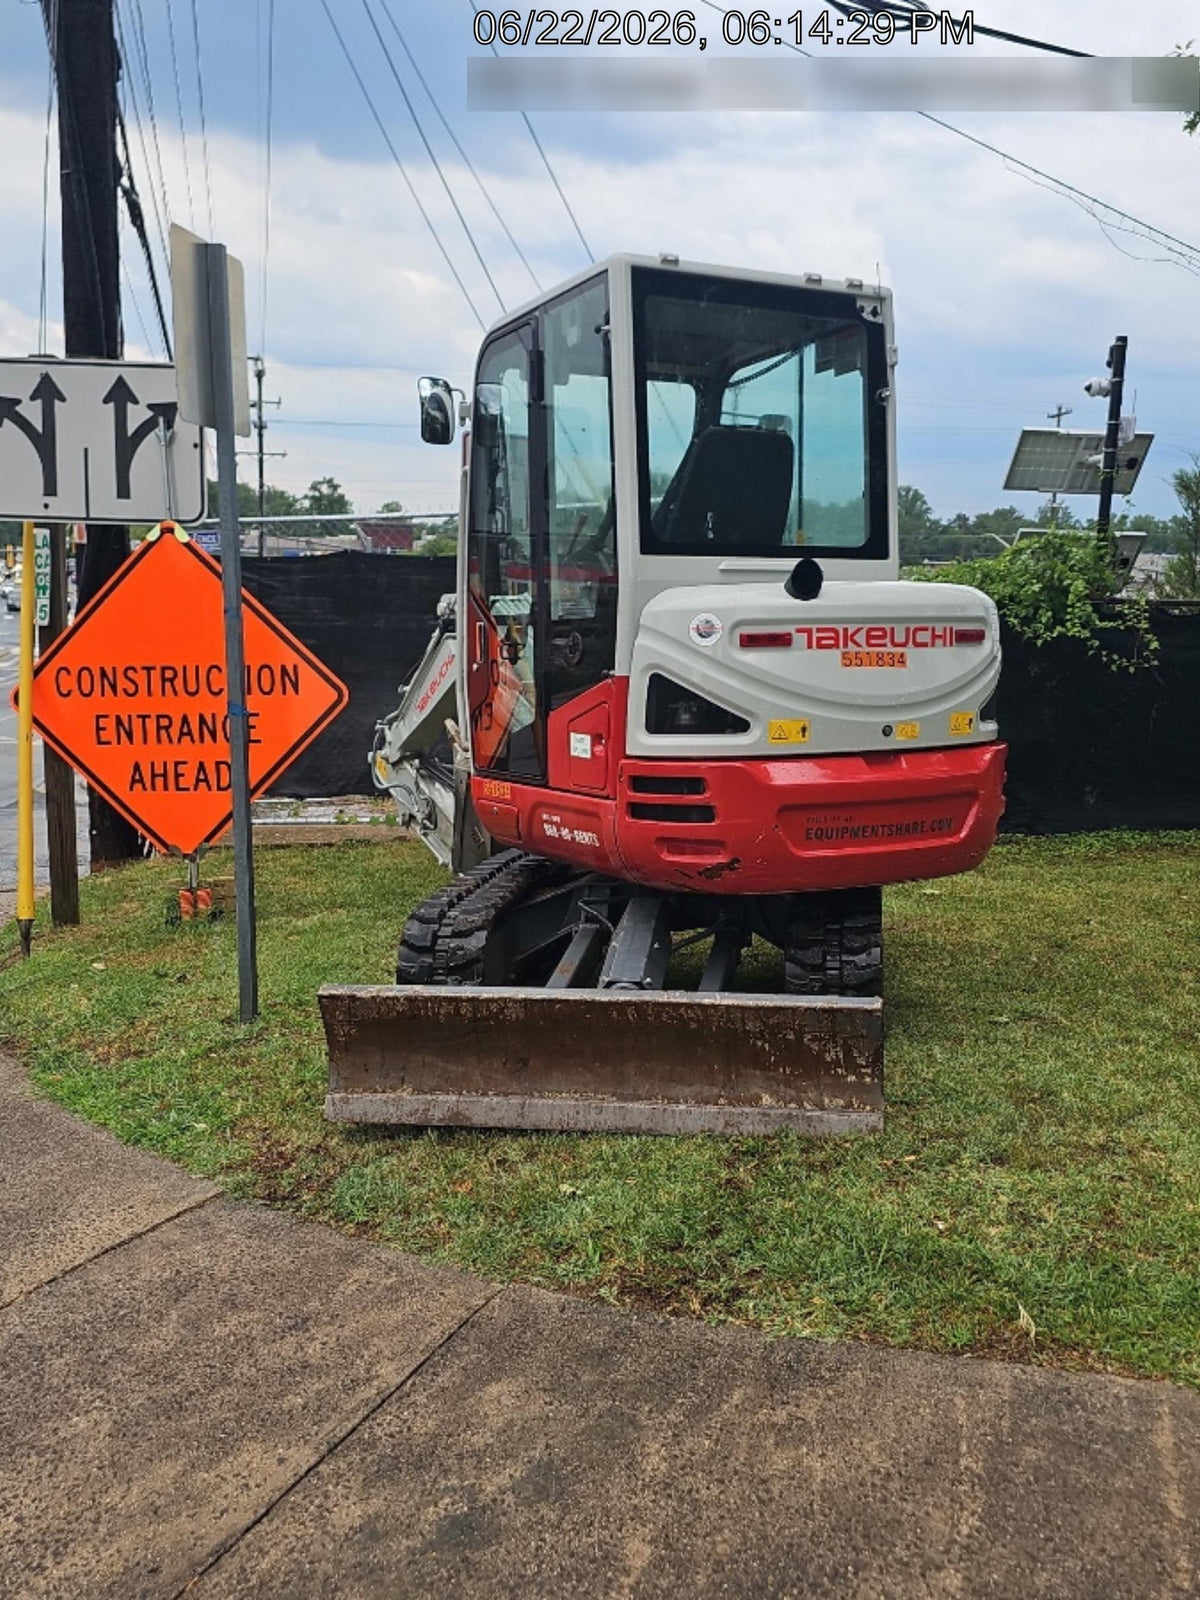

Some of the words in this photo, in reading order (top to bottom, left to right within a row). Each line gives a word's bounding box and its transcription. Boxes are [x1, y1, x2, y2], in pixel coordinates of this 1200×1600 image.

[795, 626, 953, 650] TAKEUCHI
[842, 652, 906, 667] 551834
[55, 665, 300, 698] CONSTRUCION
[130, 760, 233, 791] AHEAD
[805, 817, 953, 841] EQUIPMENTSHARE.COM
